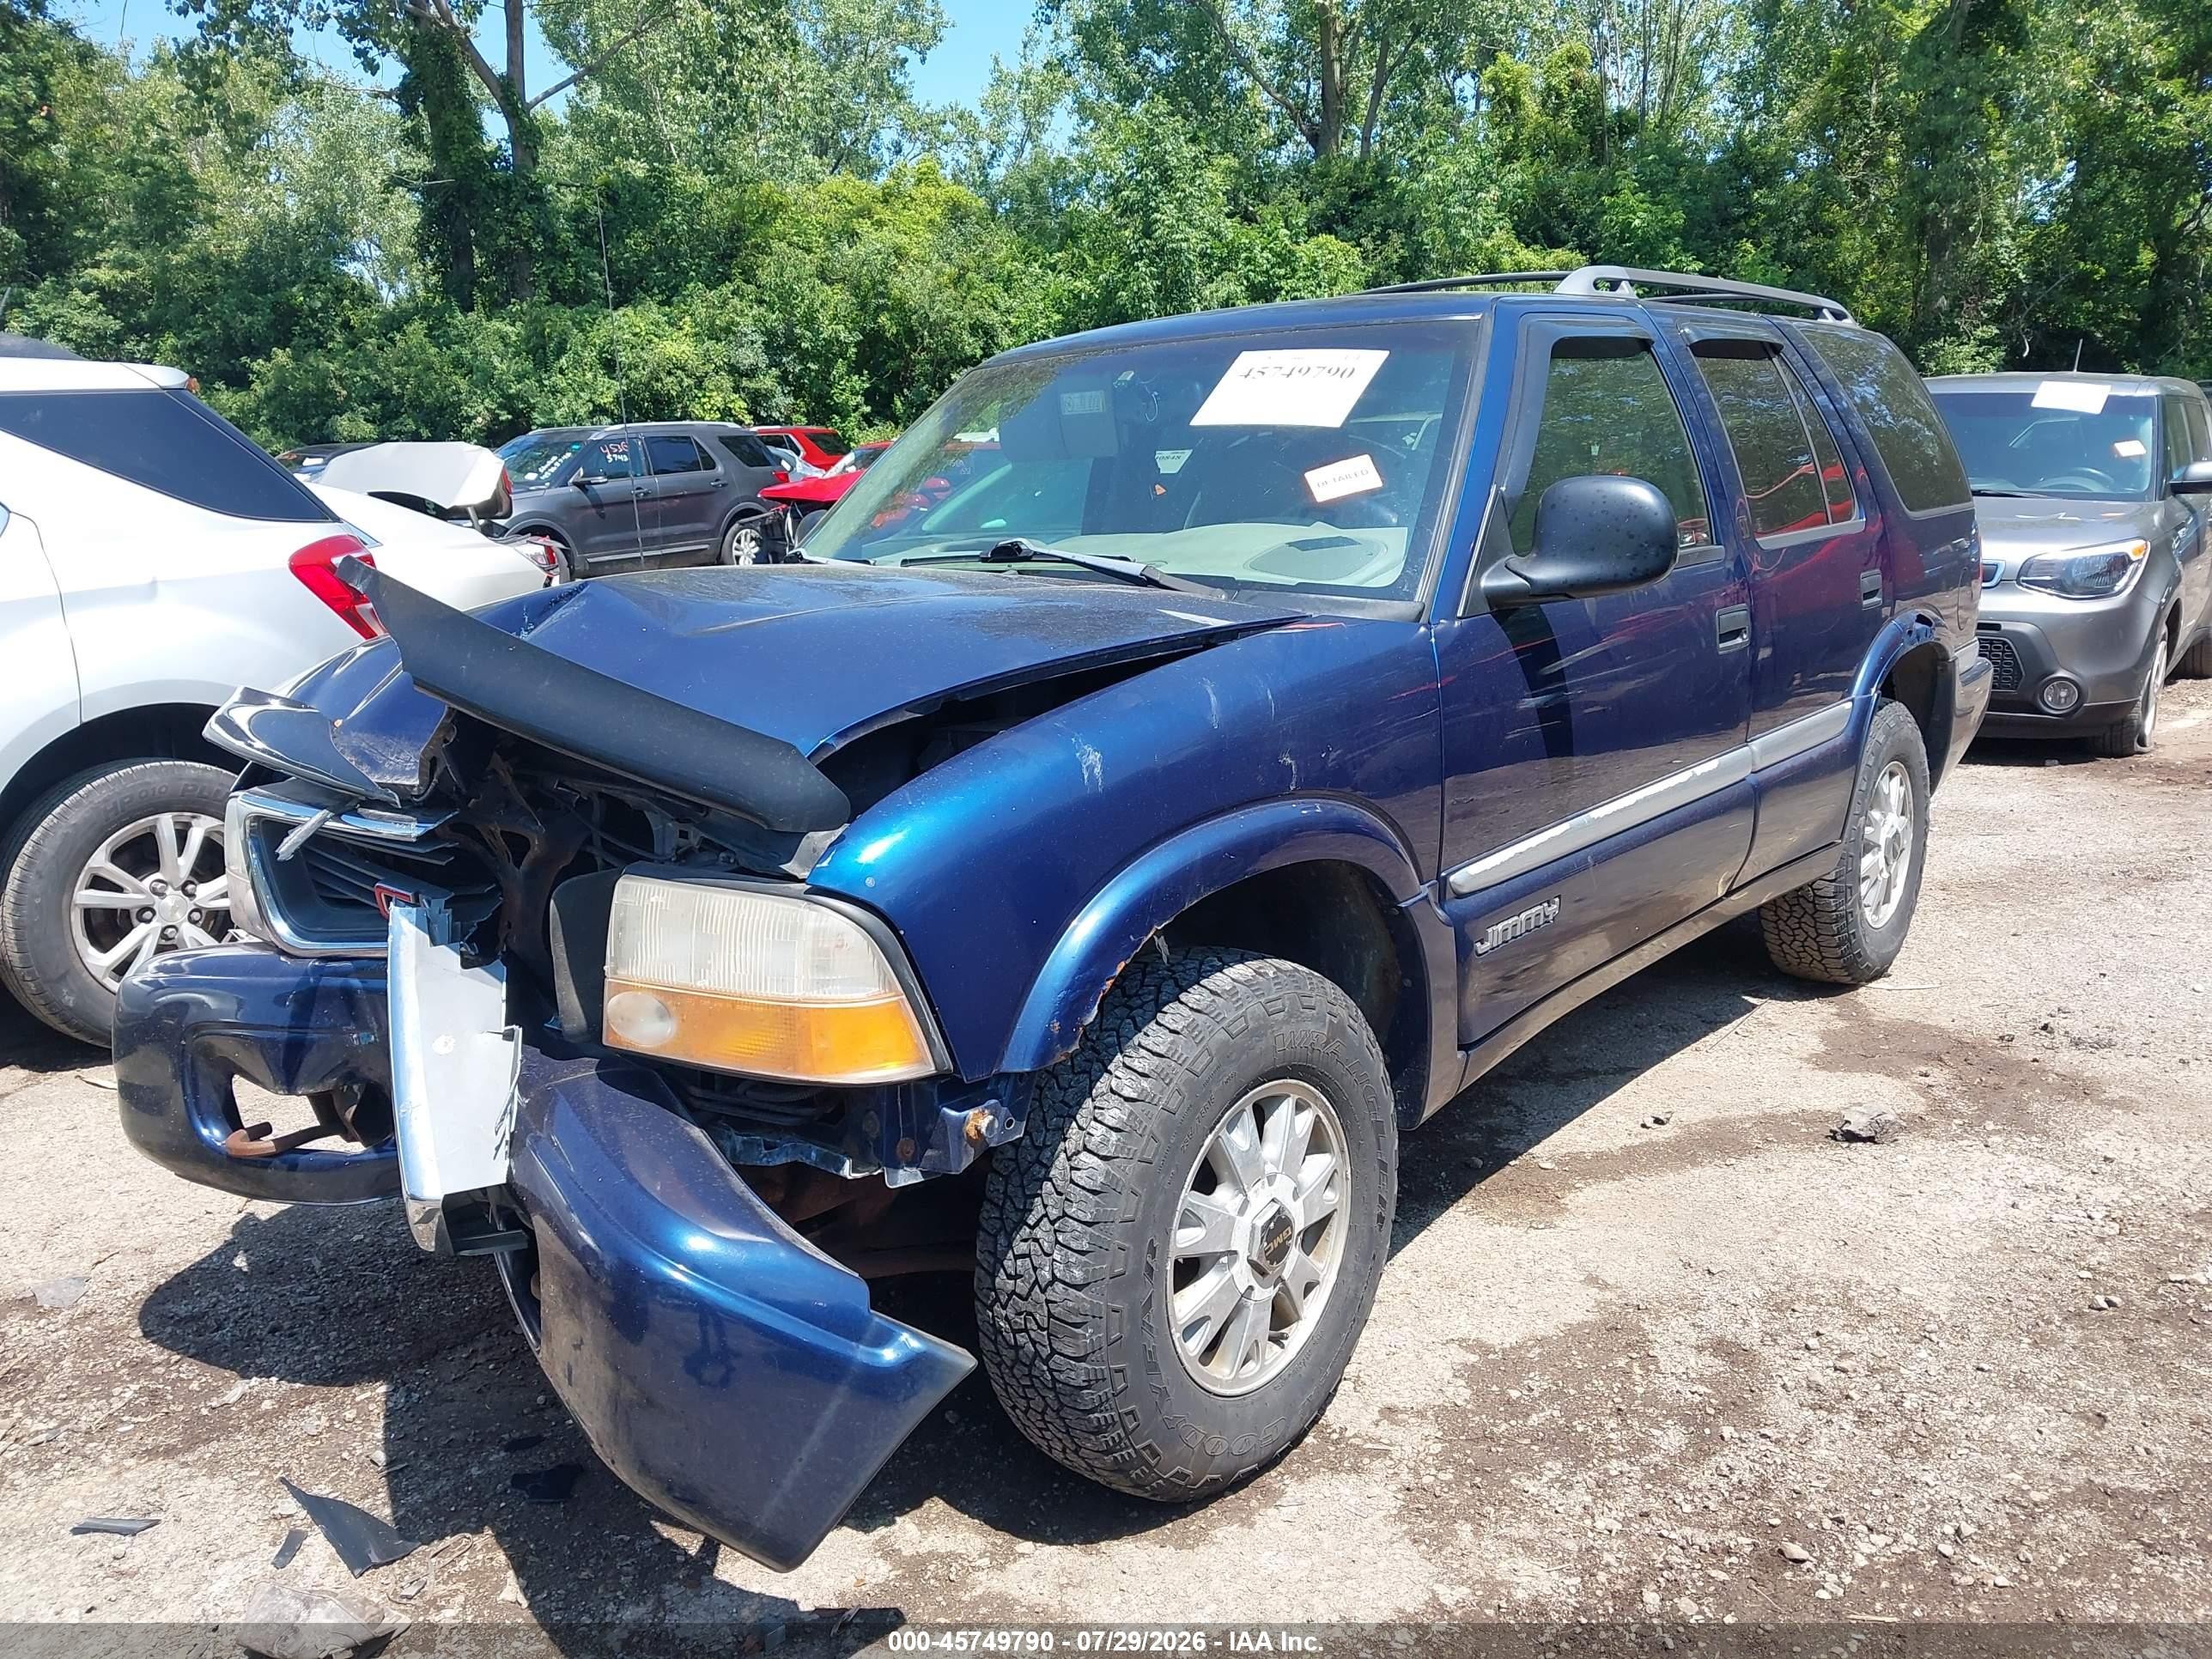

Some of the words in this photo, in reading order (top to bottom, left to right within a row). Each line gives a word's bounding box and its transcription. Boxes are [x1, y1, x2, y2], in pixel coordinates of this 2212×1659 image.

[1237, 365, 1356, 380] 45749790
[1273, 1029, 1389, 1233] WRANGLER
[1264, 1225, 1292, 1256] GMC
[1139, 1237, 1288, 1456] GOODYEAR
